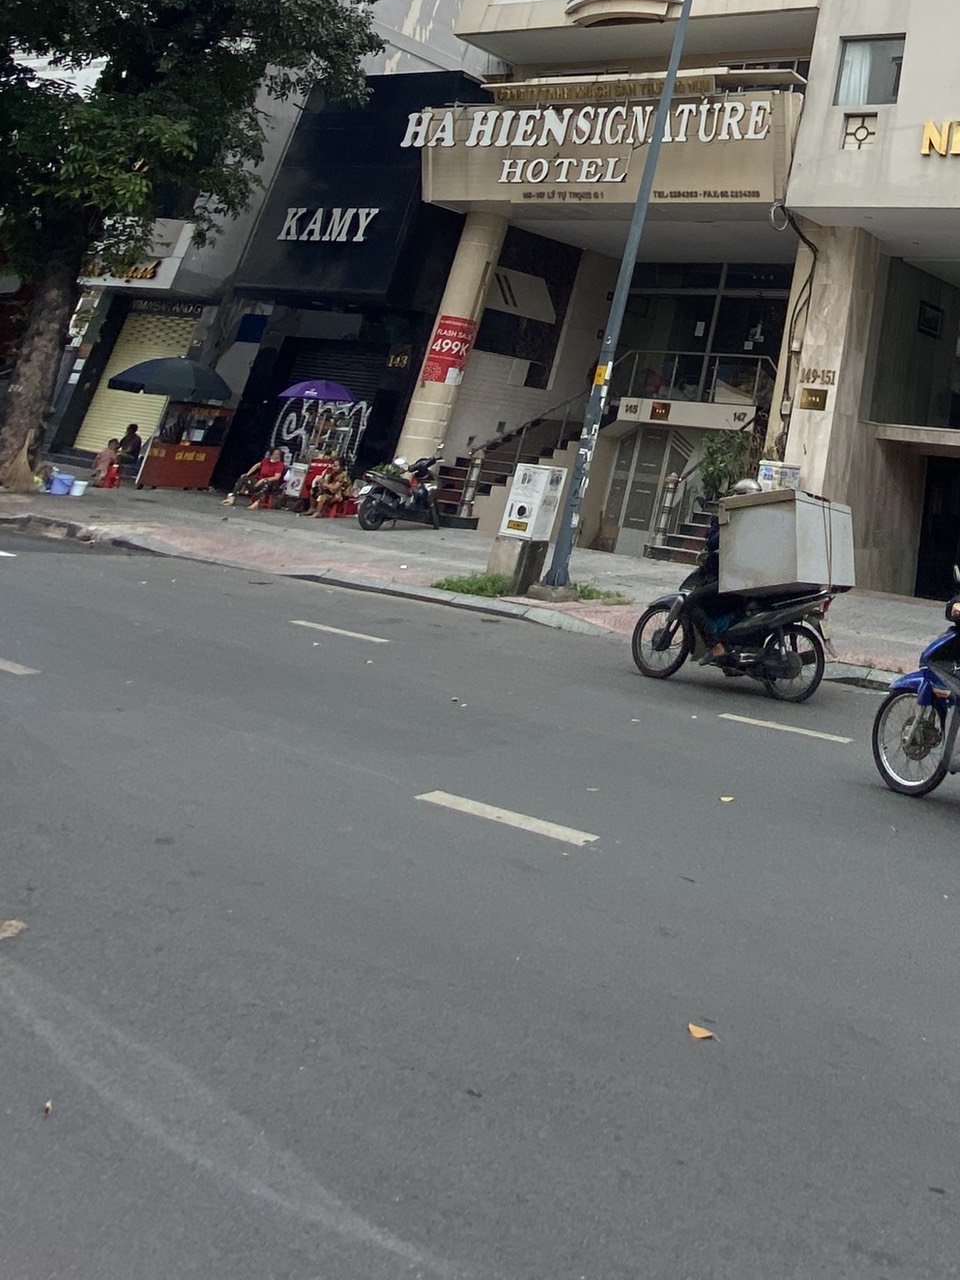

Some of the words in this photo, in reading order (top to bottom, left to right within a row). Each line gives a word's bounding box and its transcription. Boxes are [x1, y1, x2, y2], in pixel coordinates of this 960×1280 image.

[497, 157, 628, 184] HOTEL
[276, 207, 380, 242] KAMY
[432, 338, 470, 356] 499K
[800, 368, 837, 385] 149-151
